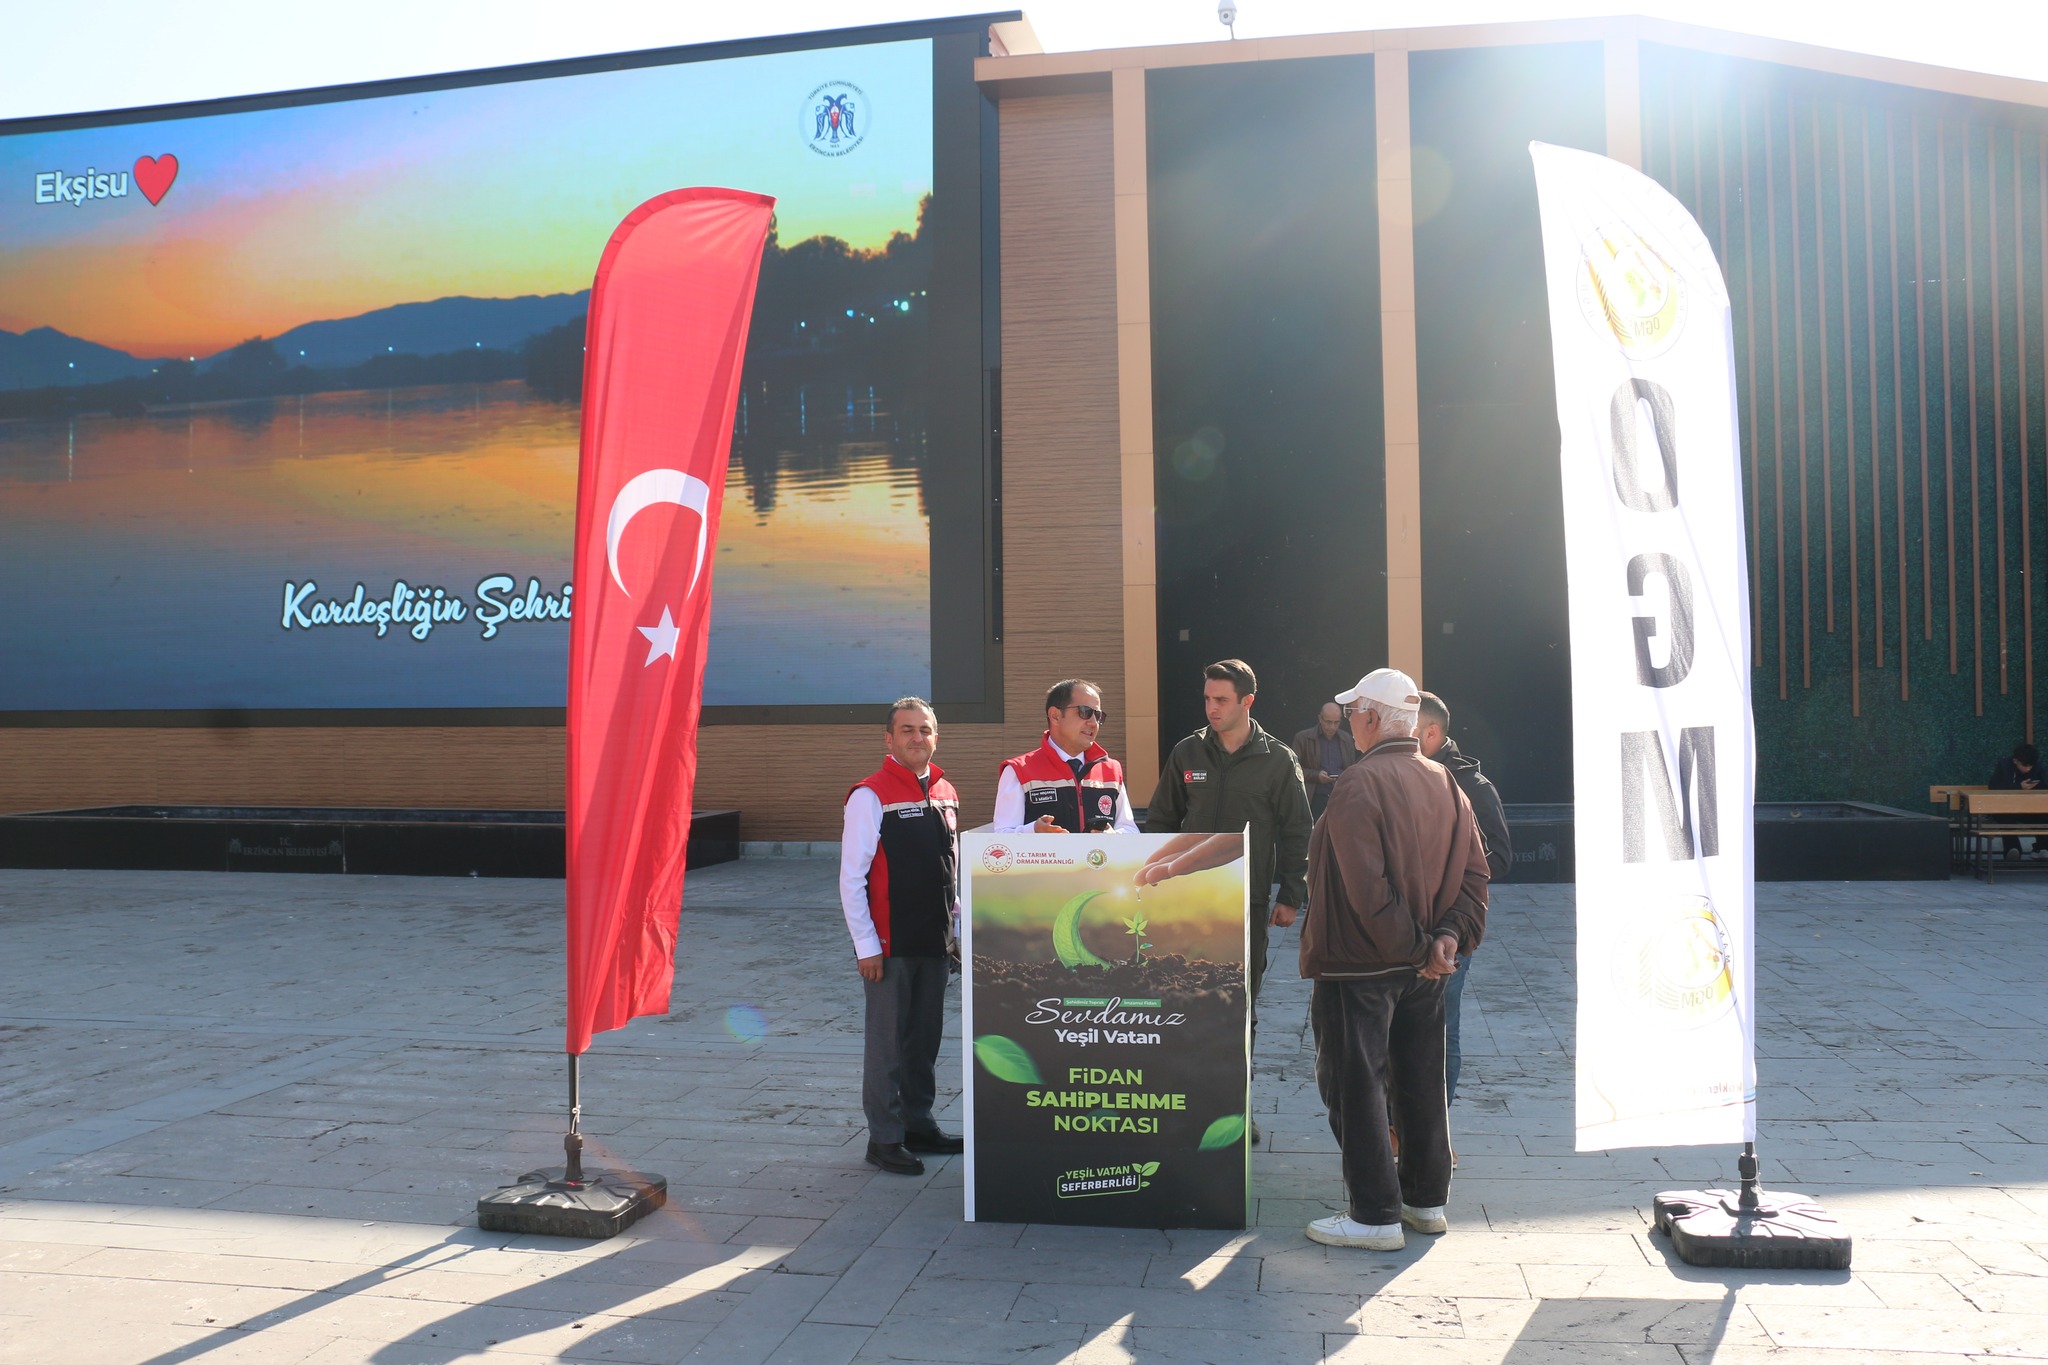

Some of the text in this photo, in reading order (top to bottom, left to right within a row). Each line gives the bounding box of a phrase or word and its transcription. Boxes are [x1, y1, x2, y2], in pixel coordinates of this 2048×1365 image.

[35, 167, 129, 207] Ekşisu
[281, 575, 573, 641] Kardeşliğin Şehri
[1025, 997, 1186, 1026] Sevdamız
[1054, 1028, 1161, 1047] Yeşil Vatan
[1054, 1115, 1159, 1134] NOKTASI
[1065, 1165, 1130, 1180] YEŞİL VATAN
[1061, 1174, 1137, 1192] SEFERBERLİĞİ
